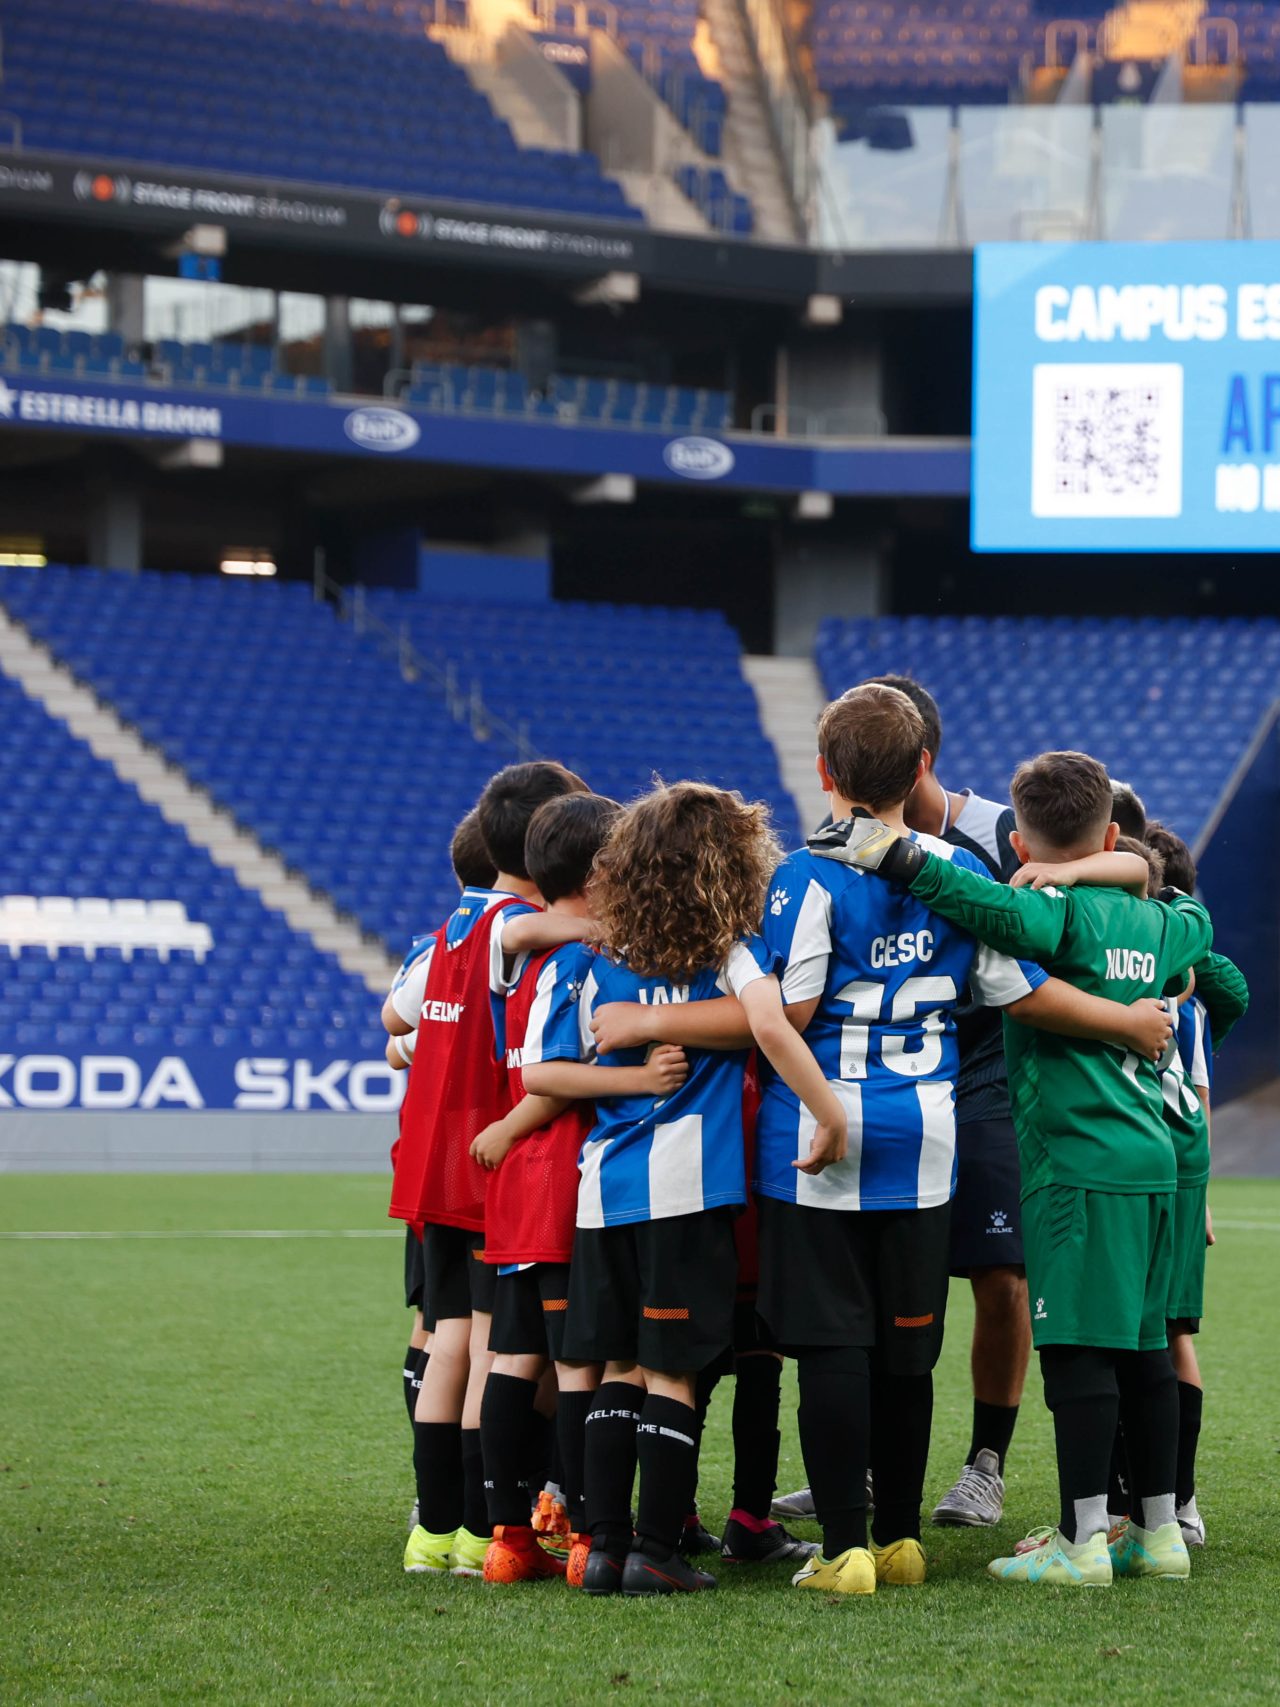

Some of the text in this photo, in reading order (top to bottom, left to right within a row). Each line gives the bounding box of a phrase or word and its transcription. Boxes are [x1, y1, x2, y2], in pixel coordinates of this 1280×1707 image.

[1034, 284, 1228, 342] CAMPUS
[19, 390, 141, 430] ESTRELLA
[871, 929, 934, 969] CESC
[421, 999, 465, 1023] KELM
[834, 976, 957, 1079] 15
[585, 1409, 632, 1424] KELME
